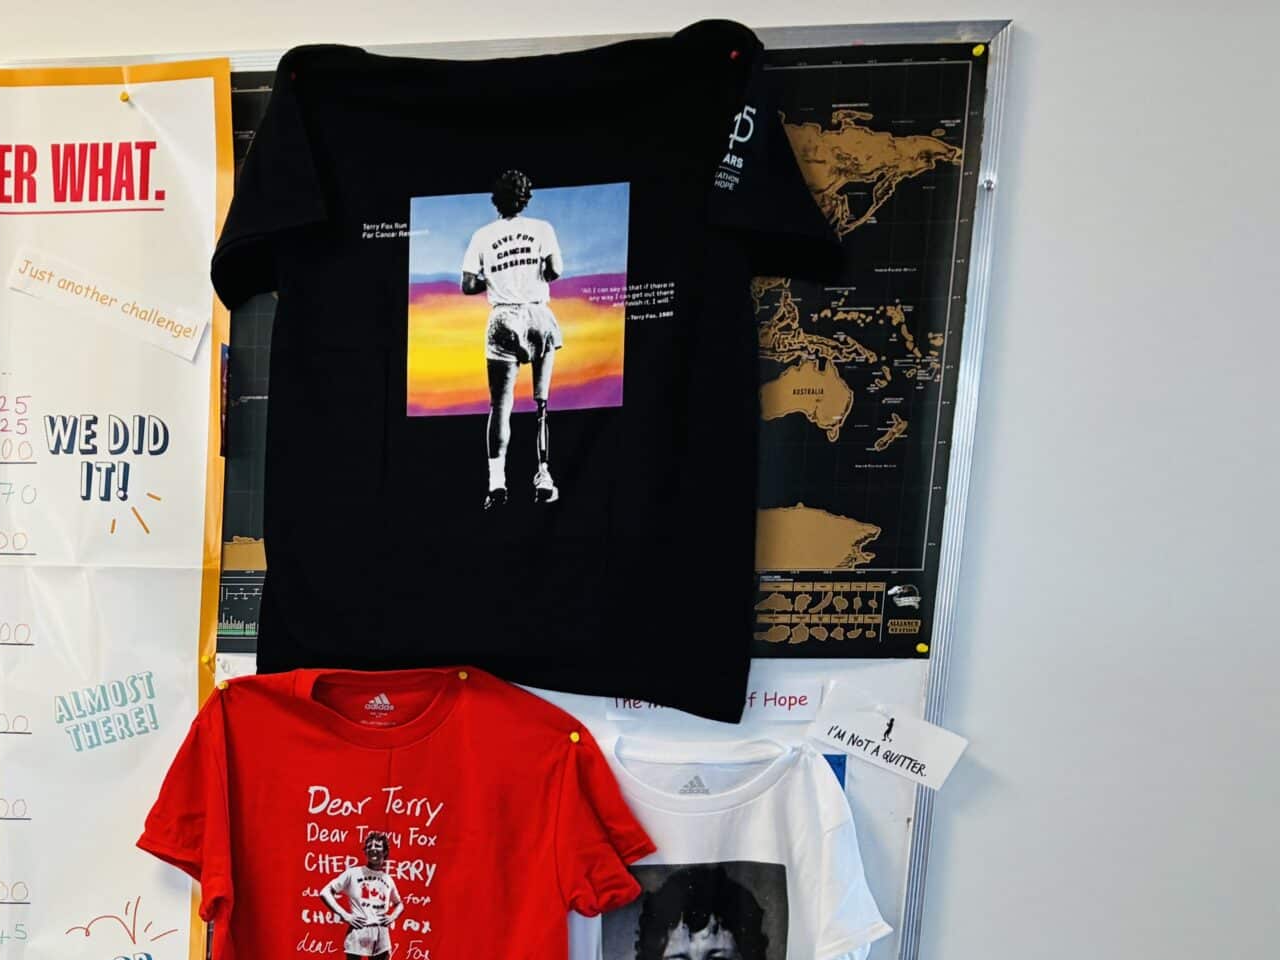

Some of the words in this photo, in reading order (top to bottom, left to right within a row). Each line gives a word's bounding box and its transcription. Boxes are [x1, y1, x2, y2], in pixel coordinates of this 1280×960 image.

[50, 140, 166, 204] WHAT.
[492, 234, 514, 250] GIVE
[516, 232, 535, 243] FOR
[497, 246, 531, 261] CANCER
[491, 257, 539, 273] RESEARCH
[18, 259, 56, 285] Just
[57, 277, 118, 310] another
[120, 299, 198, 339] challenge!
[792, 388, 824, 396] AUSTRALIA
[43, 414, 99, 456] WE
[107, 414, 170, 456] DID
[80, 460, 131, 502] IT!
[53, 670, 156, 725] ALMOST
[764, 691, 809, 707] Hope
[65, 703, 160, 752] THERE!
[827, 725, 846, 741] I'M
[870, 744, 881, 757] A
[882, 749, 927, 777] QUITTER.
[307, 785, 372, 817] Dear
[381, 785, 444, 827] Terry
[307, 823, 348, 843] Dear
[409, 827, 437, 848] Fox
